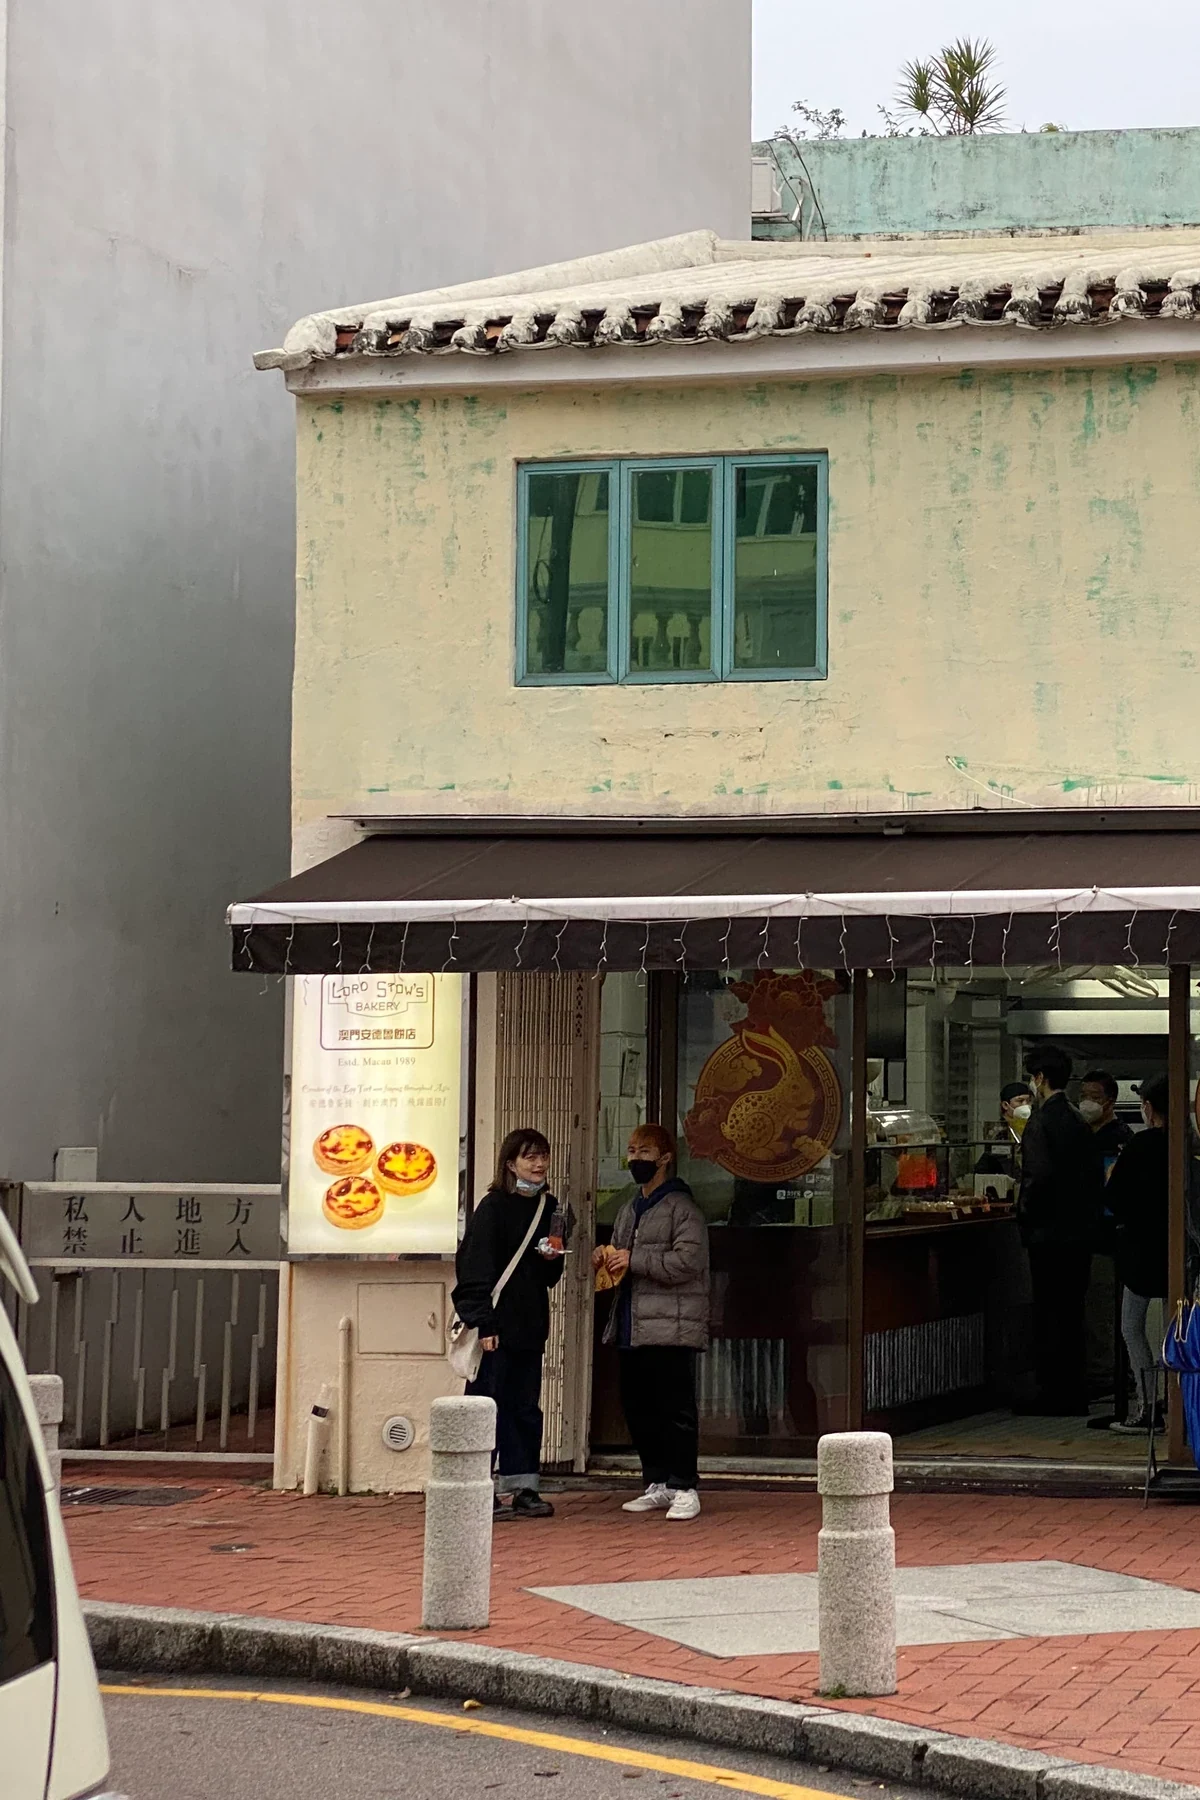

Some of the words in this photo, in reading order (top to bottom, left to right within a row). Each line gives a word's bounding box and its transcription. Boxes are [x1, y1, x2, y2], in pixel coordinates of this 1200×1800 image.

[356, 1001, 401, 1012] BAKERY
[338, 1029, 416, 1041] 澳門安德魯餅店
[338, 1058, 359, 1066] Estd.
[362, 1057, 392, 1066] Macau
[395, 1057, 416, 1065] 1989
[62, 1196, 254, 1225] 私人地方
[62, 1227, 252, 1256] 禁止進入
